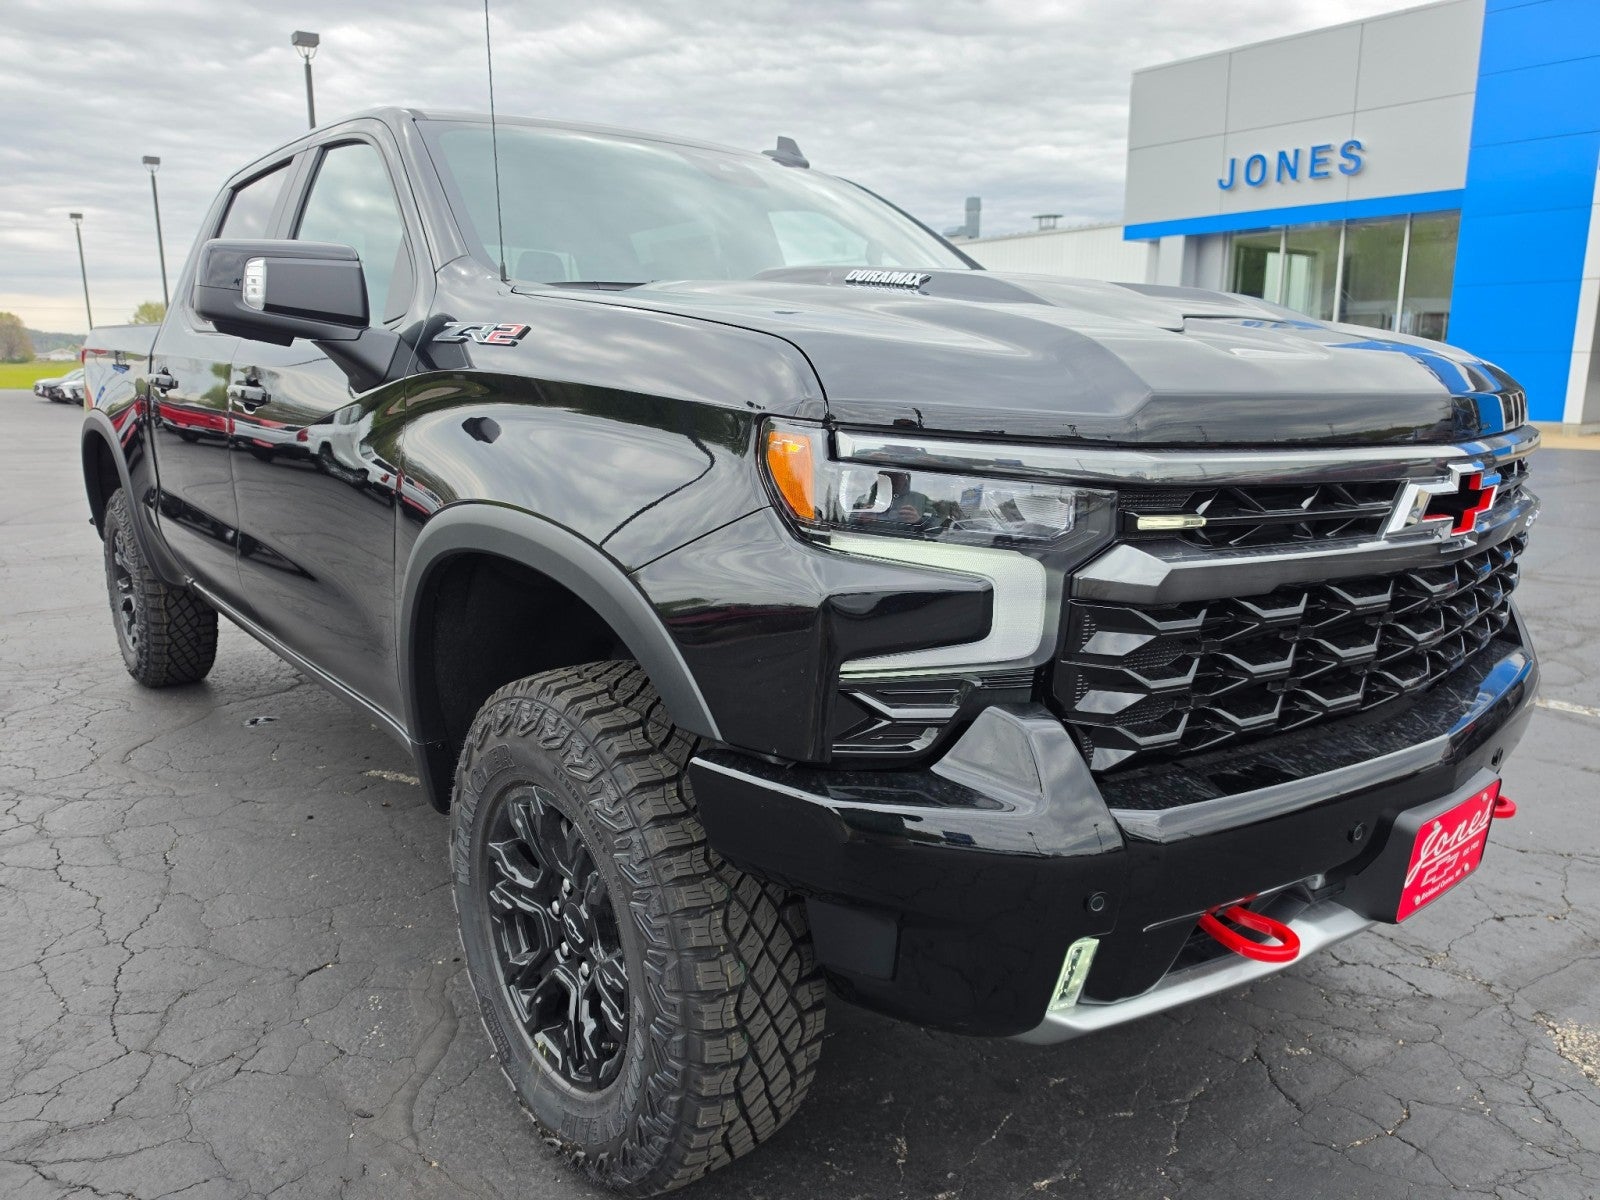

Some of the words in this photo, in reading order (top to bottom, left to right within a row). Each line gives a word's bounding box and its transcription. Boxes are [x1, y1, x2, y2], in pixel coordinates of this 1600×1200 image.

[1218, 140, 1364, 190] JONES
[845, 269, 931, 289] DURAMAX
[432, 321, 531, 347] ZR2
[456, 743, 516, 886] WRANGLER
[1404, 799, 1493, 888] Jones
